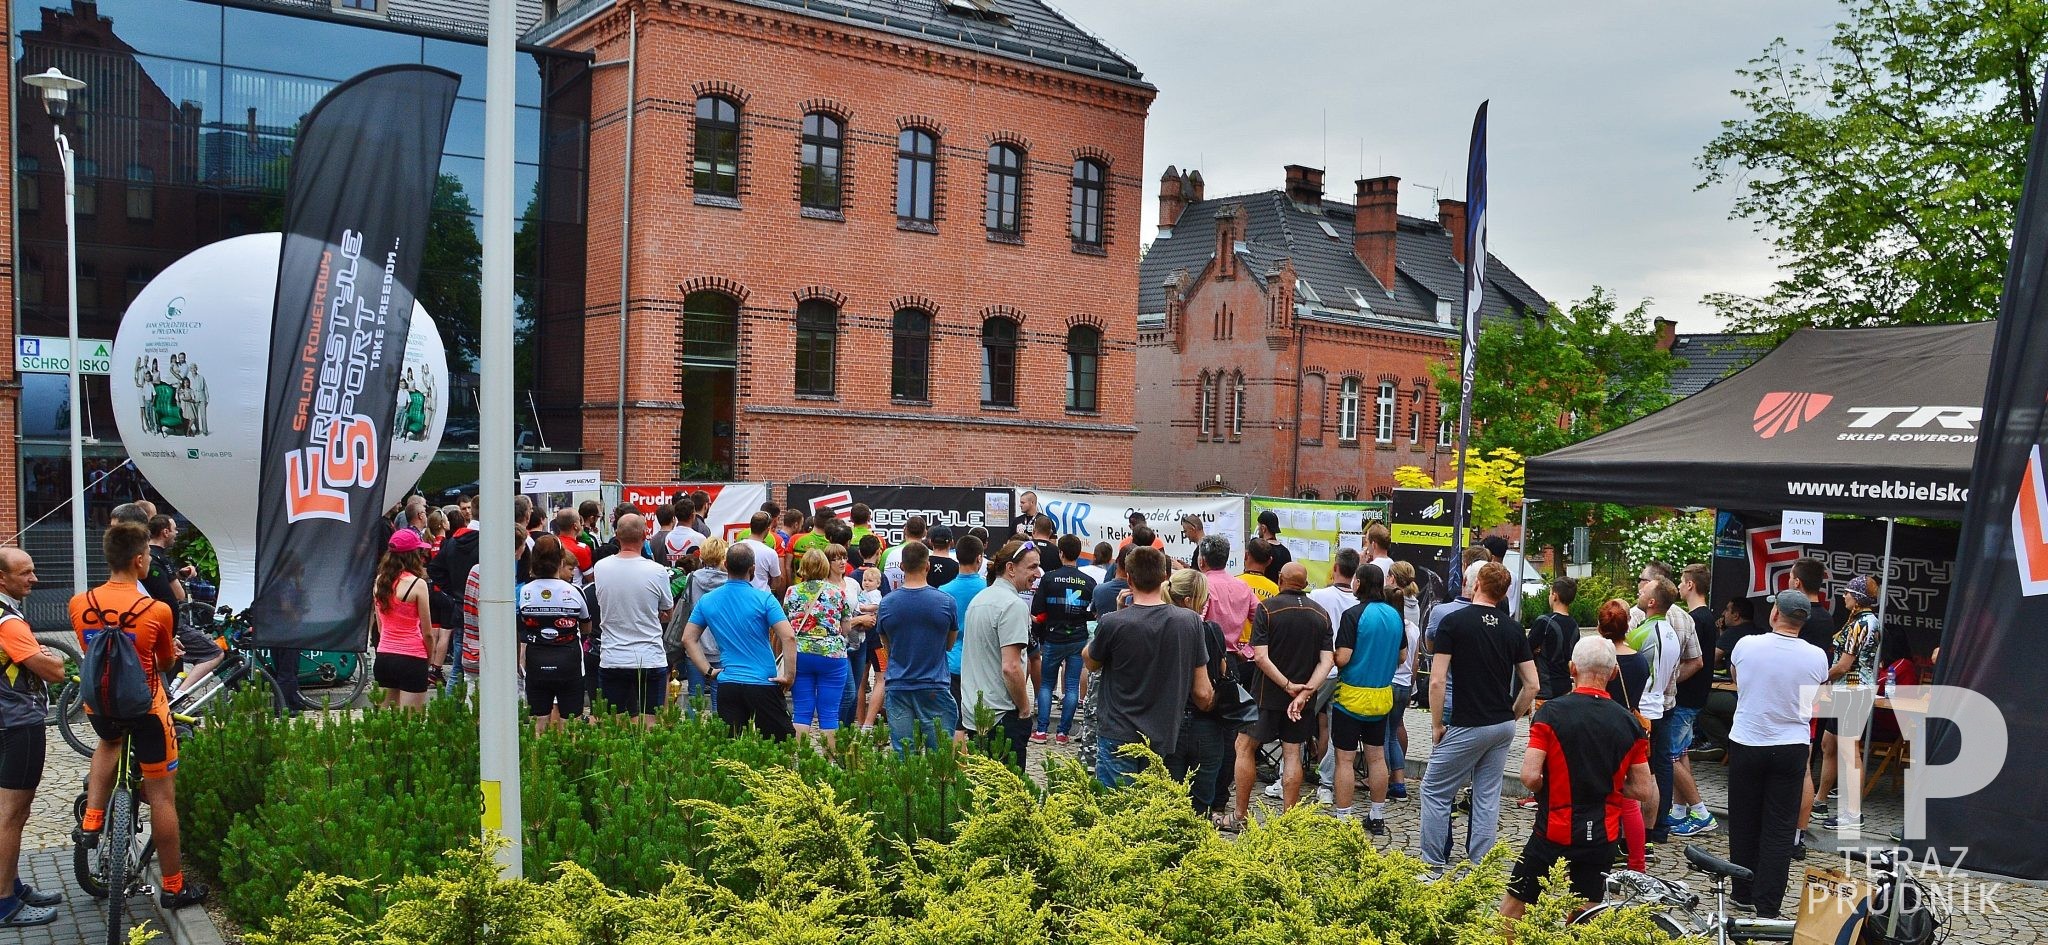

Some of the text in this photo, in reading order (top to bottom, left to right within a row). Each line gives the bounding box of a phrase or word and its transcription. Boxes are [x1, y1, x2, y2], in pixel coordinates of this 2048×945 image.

[293, 251, 333, 432] SALON ROWEROWY
[370, 329, 385, 371] TAKE
[22, 357, 110, 372] SCHROISKO
[324, 295, 378, 488] SPORT
[1847, 406, 1983, 429] TR
[1837, 433, 1979, 443] SKLEP ROWEROW
[1788, 480, 1968, 503] www.trekbielsko
[630, 492, 672, 506] Prudn
[1124, 508, 1170, 522] Oodek
[1788, 517, 1817, 526] ZAPISY
[1164, 535, 1176, 543] w
[1400, 530, 1464, 538] SHOCKBLAZ
[1054, 576, 1086, 586] medbike
[1883, 614, 1912, 626] AKE
